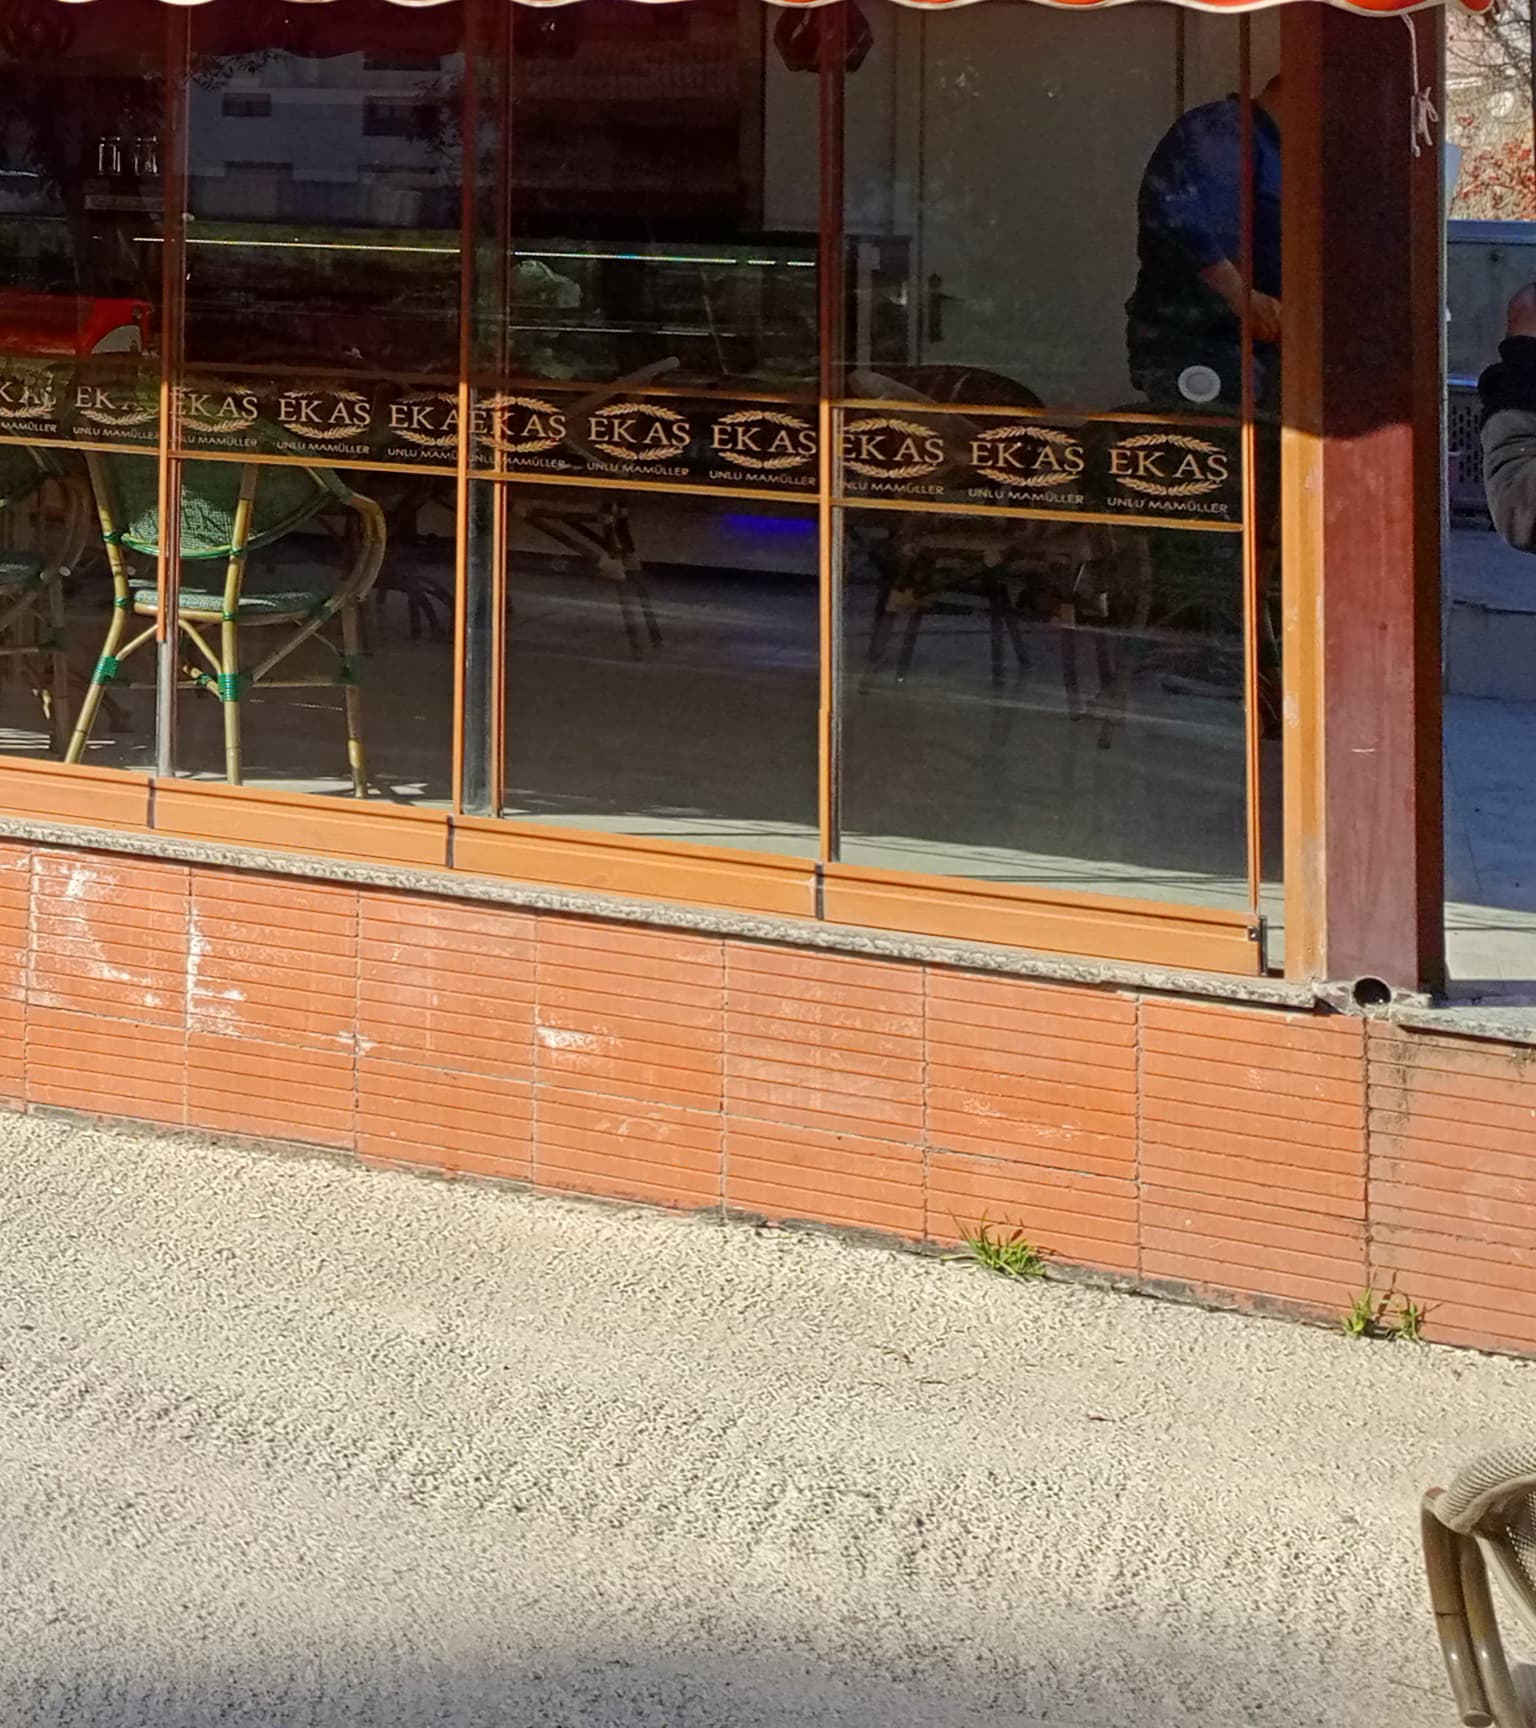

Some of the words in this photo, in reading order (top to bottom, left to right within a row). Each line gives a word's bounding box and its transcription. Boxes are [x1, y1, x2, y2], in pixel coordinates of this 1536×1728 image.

[307, 442, 370, 454] MAMÜLLER
[620, 464, 689, 477] MAMÜLLER
[709, 469, 743, 481] UNLU
[745, 473, 816, 486] MAMÜLLER
[870, 483, 944, 495] MAMÜLLER
[968, 487, 1005, 499] UNLU
[1007, 490, 1085, 504] MAMÜLLER
[1107, 496, 1146, 509] UNLU
[1147, 500, 1229, 514] MAMÜLLER
